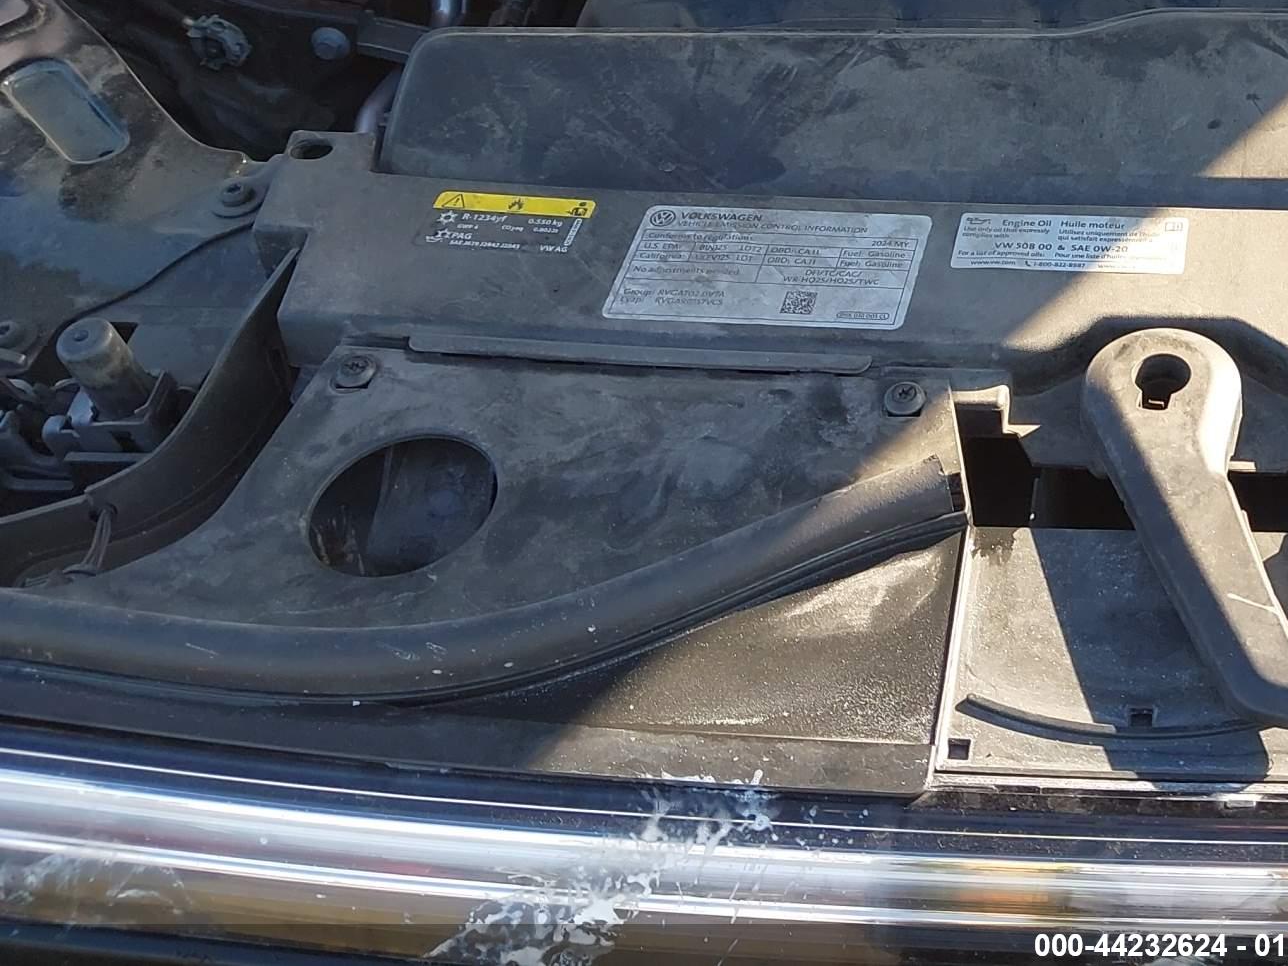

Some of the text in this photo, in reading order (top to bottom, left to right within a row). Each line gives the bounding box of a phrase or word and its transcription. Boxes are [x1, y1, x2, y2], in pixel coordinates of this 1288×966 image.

[461, 213, 508, 224] R-1234yf
[681, 211, 763, 222] VOLKSWAGEN
[528, 218, 563, 228] 0.550 kg
[679, 220, 711, 228] VEHICLE
[760, 223, 802, 231] CONTROL
[804, 225, 869, 234] INFORMATION
[1002, 219, 1034, 229] Engine
[1088, 222, 1126, 230] moteur
[540, 244, 568, 253] VW AG
[872, 240, 891, 248] 2024
[1016, 242, 1036, 250] 508
[1038, 243, 1053, 251] 00
[1093, 245, 1129, 253] 0W-20
[870, 251, 906, 259] Gasoline
[865, 261, 903, 269] Gasoline
